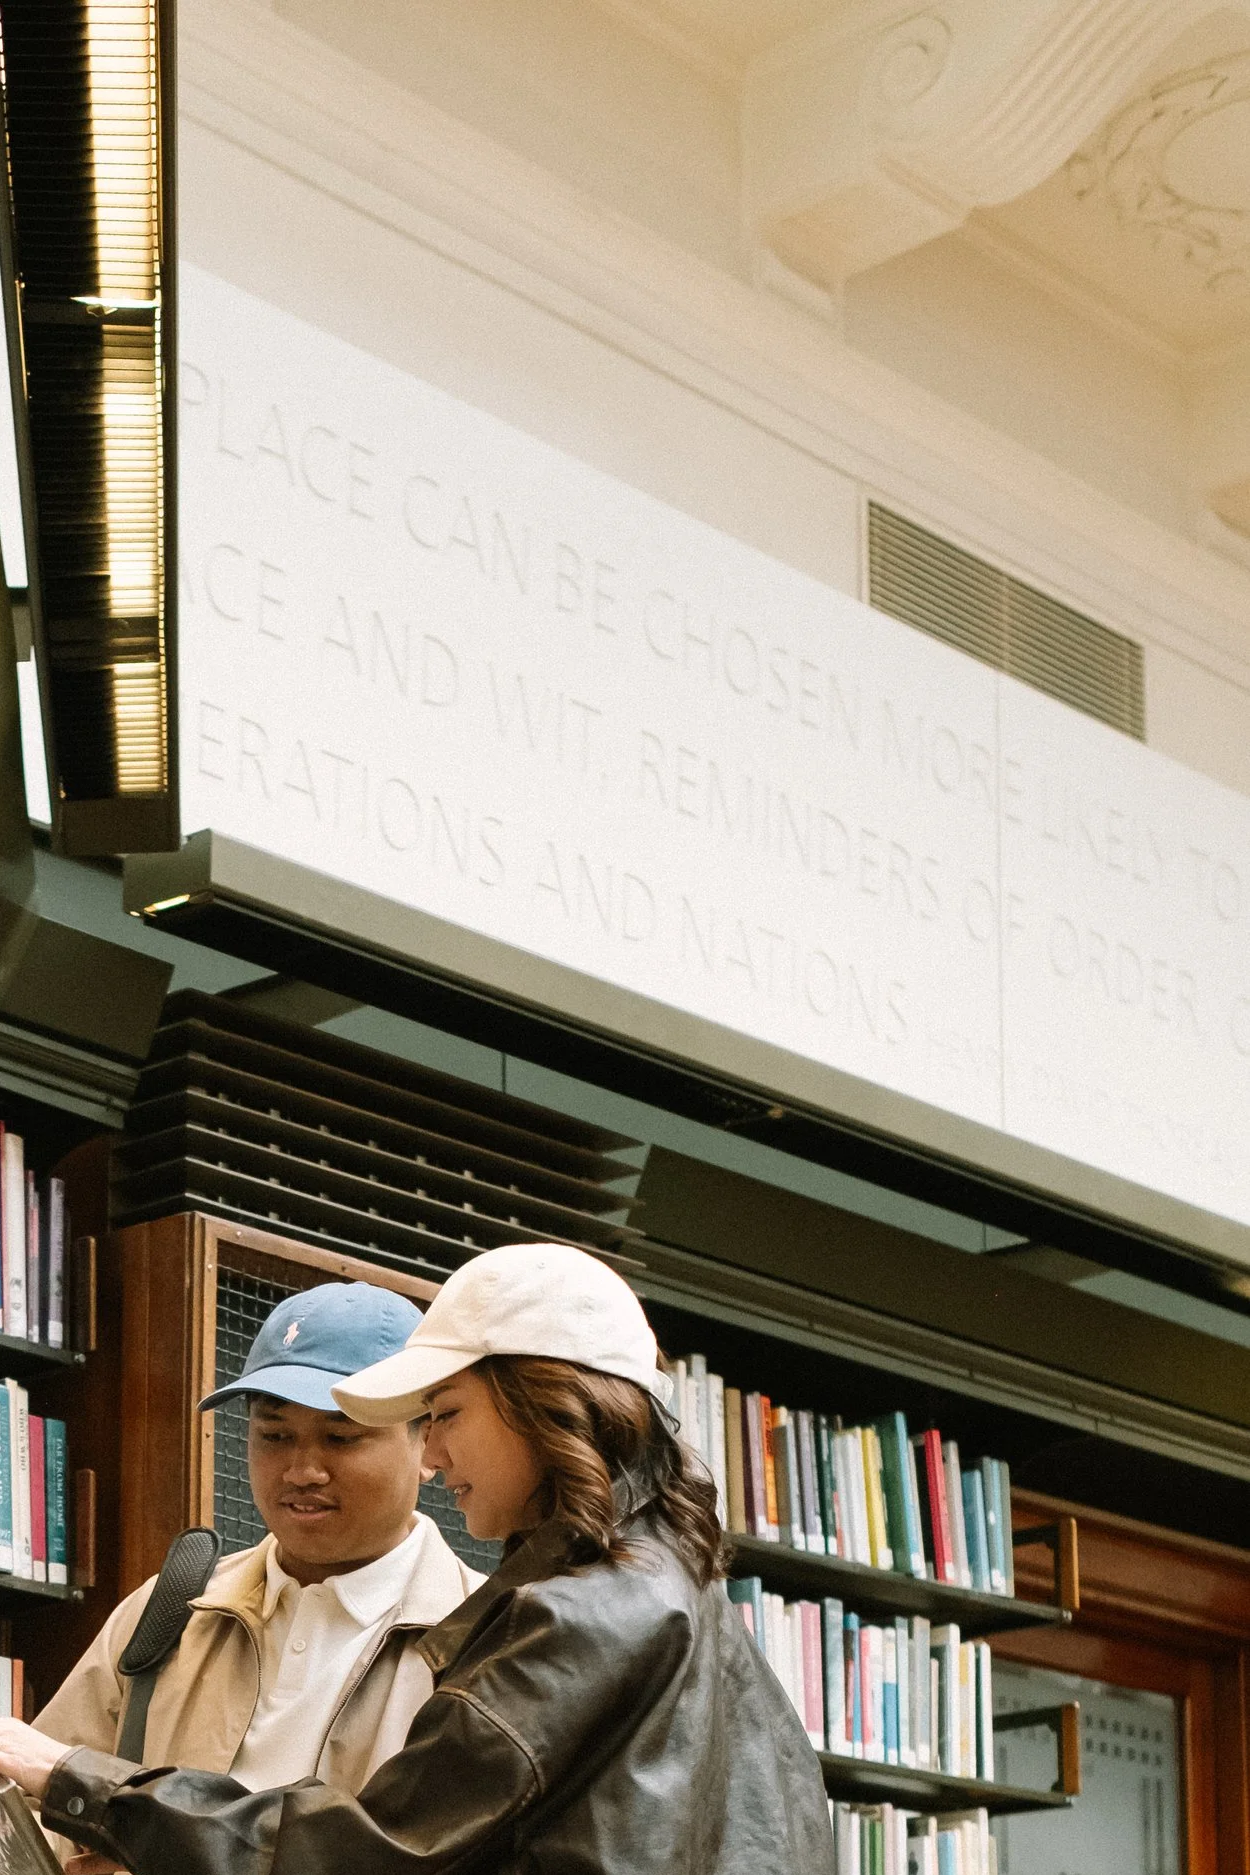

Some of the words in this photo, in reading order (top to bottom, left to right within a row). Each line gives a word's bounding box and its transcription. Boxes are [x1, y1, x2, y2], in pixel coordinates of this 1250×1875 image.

[404, 475, 528, 594] CAN
[555, 543, 617, 635] BE
[643, 589, 861, 751] CHOSEN
[880, 698, 1022, 824] MORE
[1040, 779, 1166, 888] LIKELY
[324, 594, 457, 707] AND
[638, 729, 939, 924] REMINDERS
[963, 877, 1025, 946] OF
[536, 839, 653, 943] AND
[678, 893, 906, 1046] NATIONS
[56, 1438, 64, 1457] FAR
[56, 1460, 64, 1491] FROM
[57, 1496, 65, 1528] HOME
